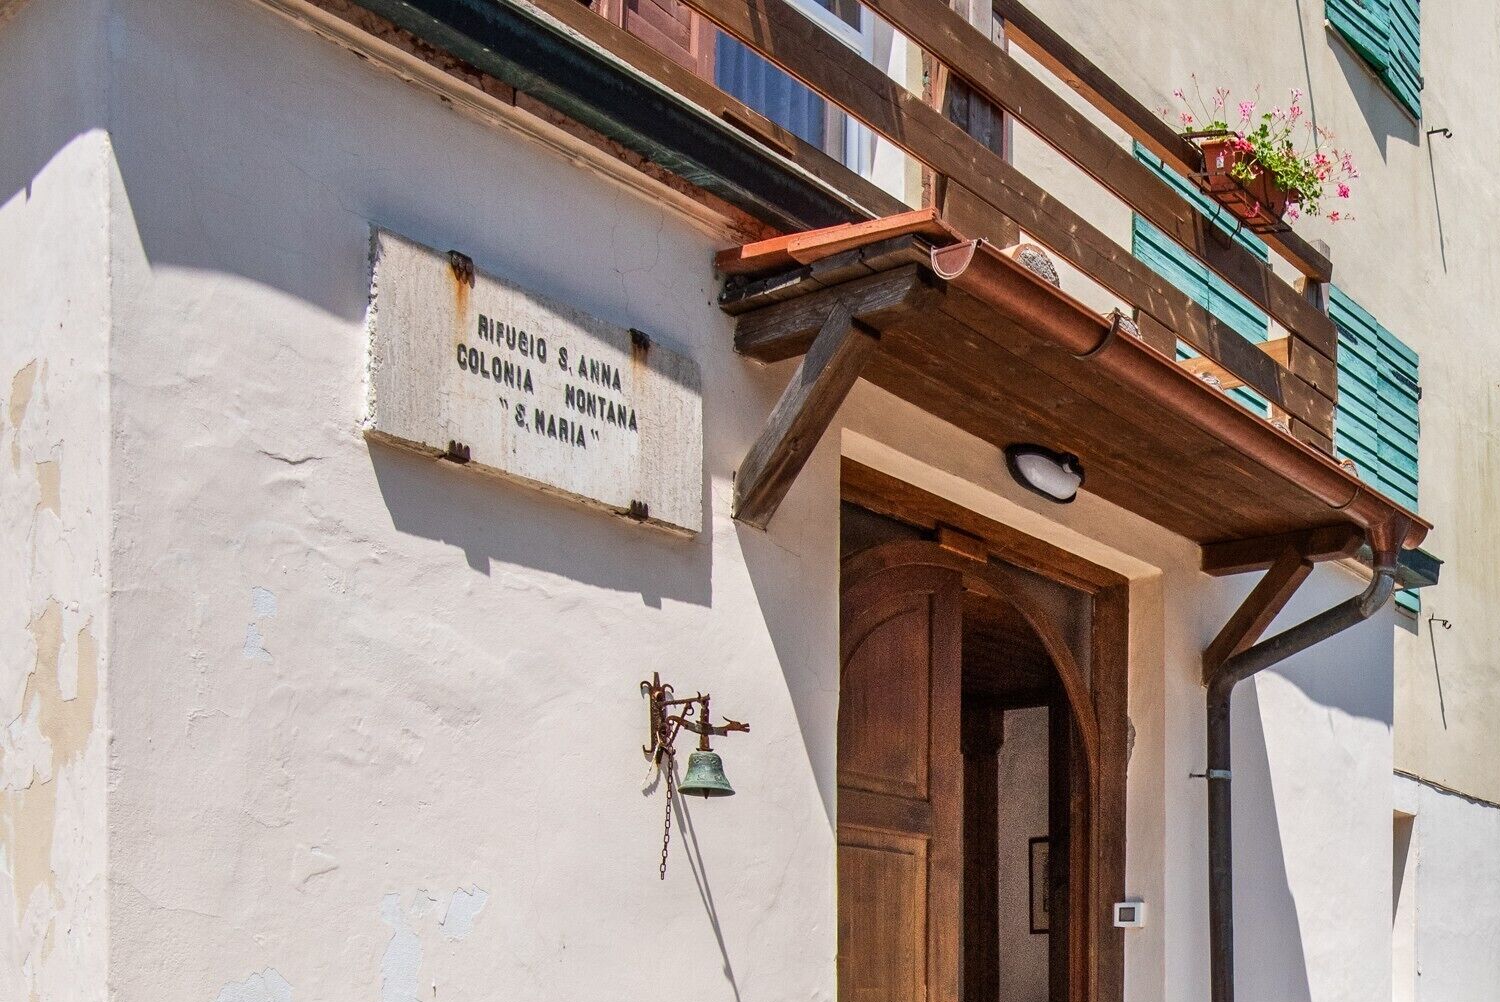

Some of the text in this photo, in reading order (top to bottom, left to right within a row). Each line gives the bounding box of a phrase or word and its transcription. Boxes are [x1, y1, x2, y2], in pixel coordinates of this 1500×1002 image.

[456, 343, 638, 433] COLONIA MONTANA
[478, 313, 622, 393] RIFUGIO S. ANNA
